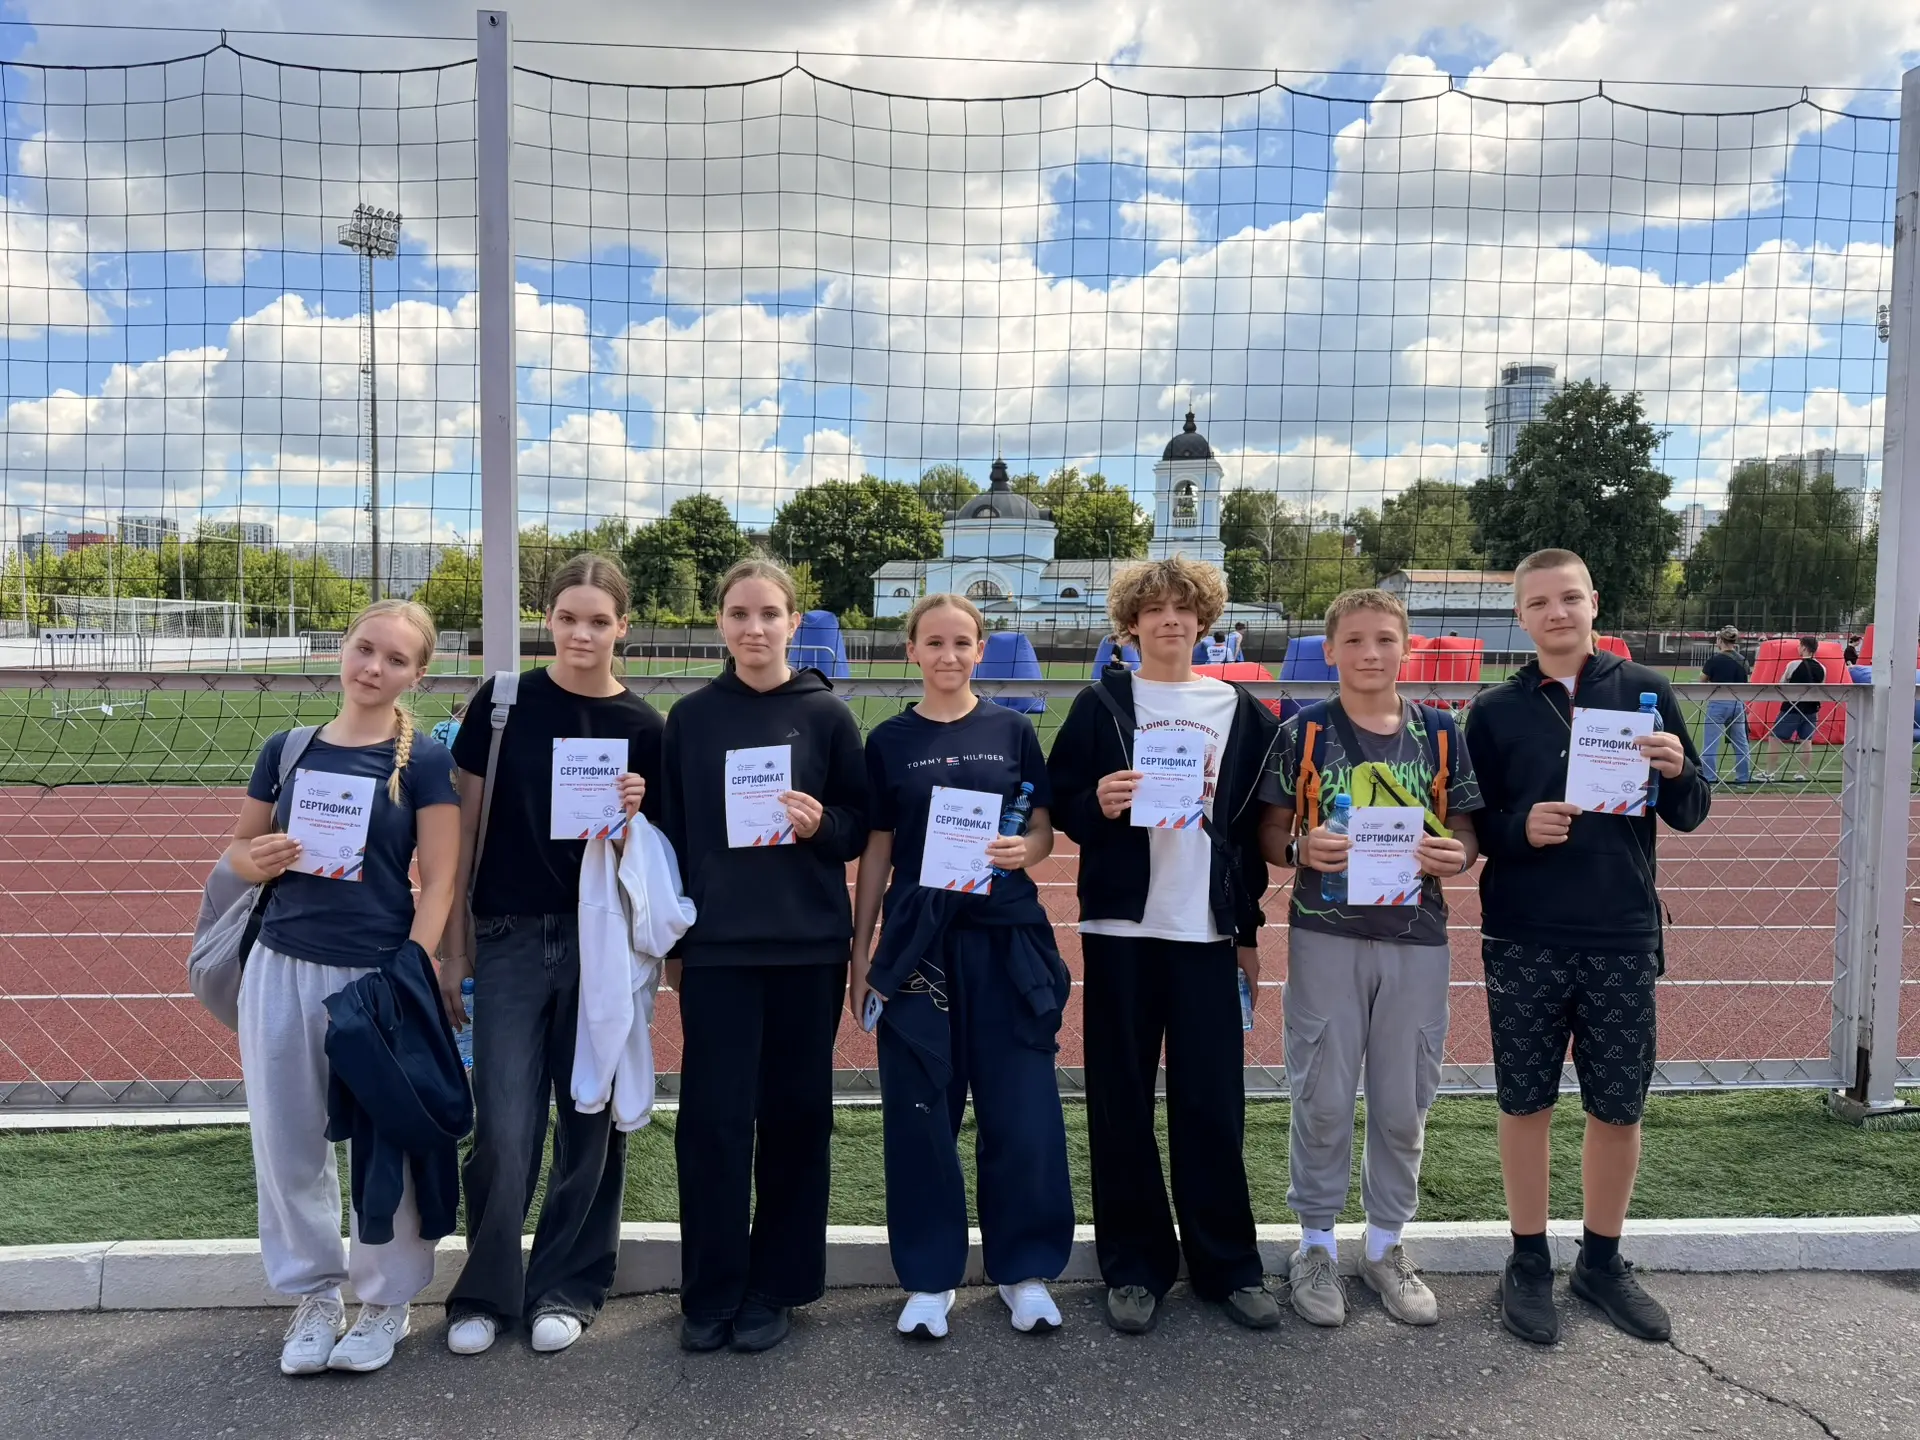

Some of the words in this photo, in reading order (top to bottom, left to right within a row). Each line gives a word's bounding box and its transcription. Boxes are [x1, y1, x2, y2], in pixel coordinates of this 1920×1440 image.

[1175, 719, 1220, 740] CONCRETE
[907, 757, 942, 770] TOMMY
[962, 753, 1004, 763] HILFIGER
[1140, 757, 1197, 767] СЕРТИФИКАТ
[560, 766, 620, 777] СЕРТИФИКАТ
[731, 773, 785, 785] СЕРТИФИКАТ
[299, 799, 363, 816] СЕРТИФИКАТ
[935, 814, 992, 830] СЕРТИФИКАТ
[1355, 833, 1415, 843] СЕРТИФИКАТ
